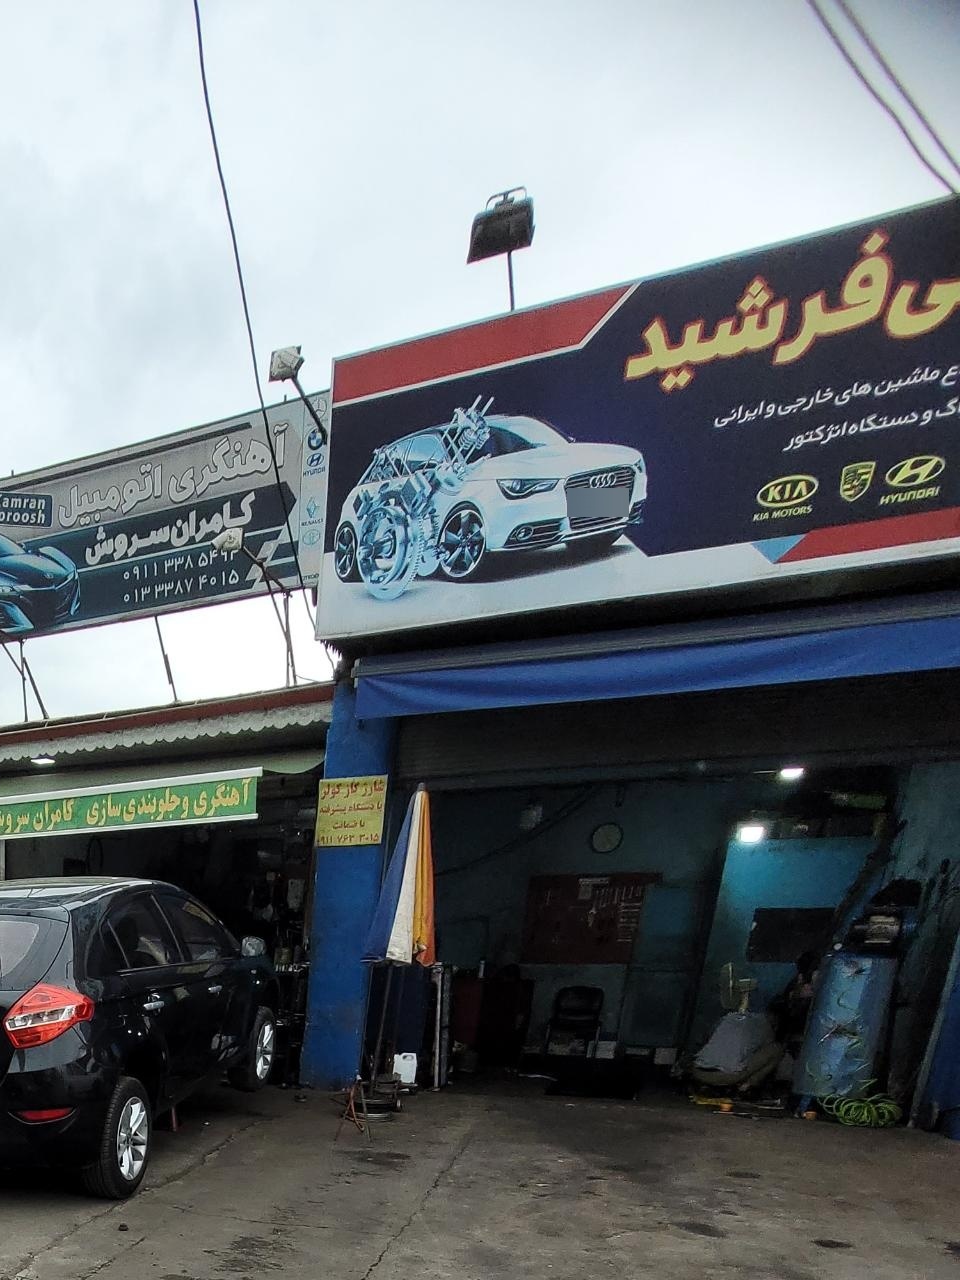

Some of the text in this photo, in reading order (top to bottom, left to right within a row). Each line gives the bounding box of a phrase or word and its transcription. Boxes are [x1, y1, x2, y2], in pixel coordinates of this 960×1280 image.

[624, 229, 893, 392] فرشید
[834, 382, 871, 405] های
[874, 366, 940, 396] ماشین
[714, 401, 763, 427] ایرانی
[777, 387, 834, 415] خارجی
[850, 412, 918, 435] دستگاه
[919, 409, 933, 426] و
[782, 421, 847, 451] انژکتور
[58, 423, 289, 527] آهنگری اتومبیل
[767, 480, 808, 502] KIA
[880, 486, 941, 505] HYUNDAI
[753, 505, 813, 522] KIA MOTORS
[85, 491, 256, 565] کامران سروش
[193, 777, 253, 816] آهنگری
